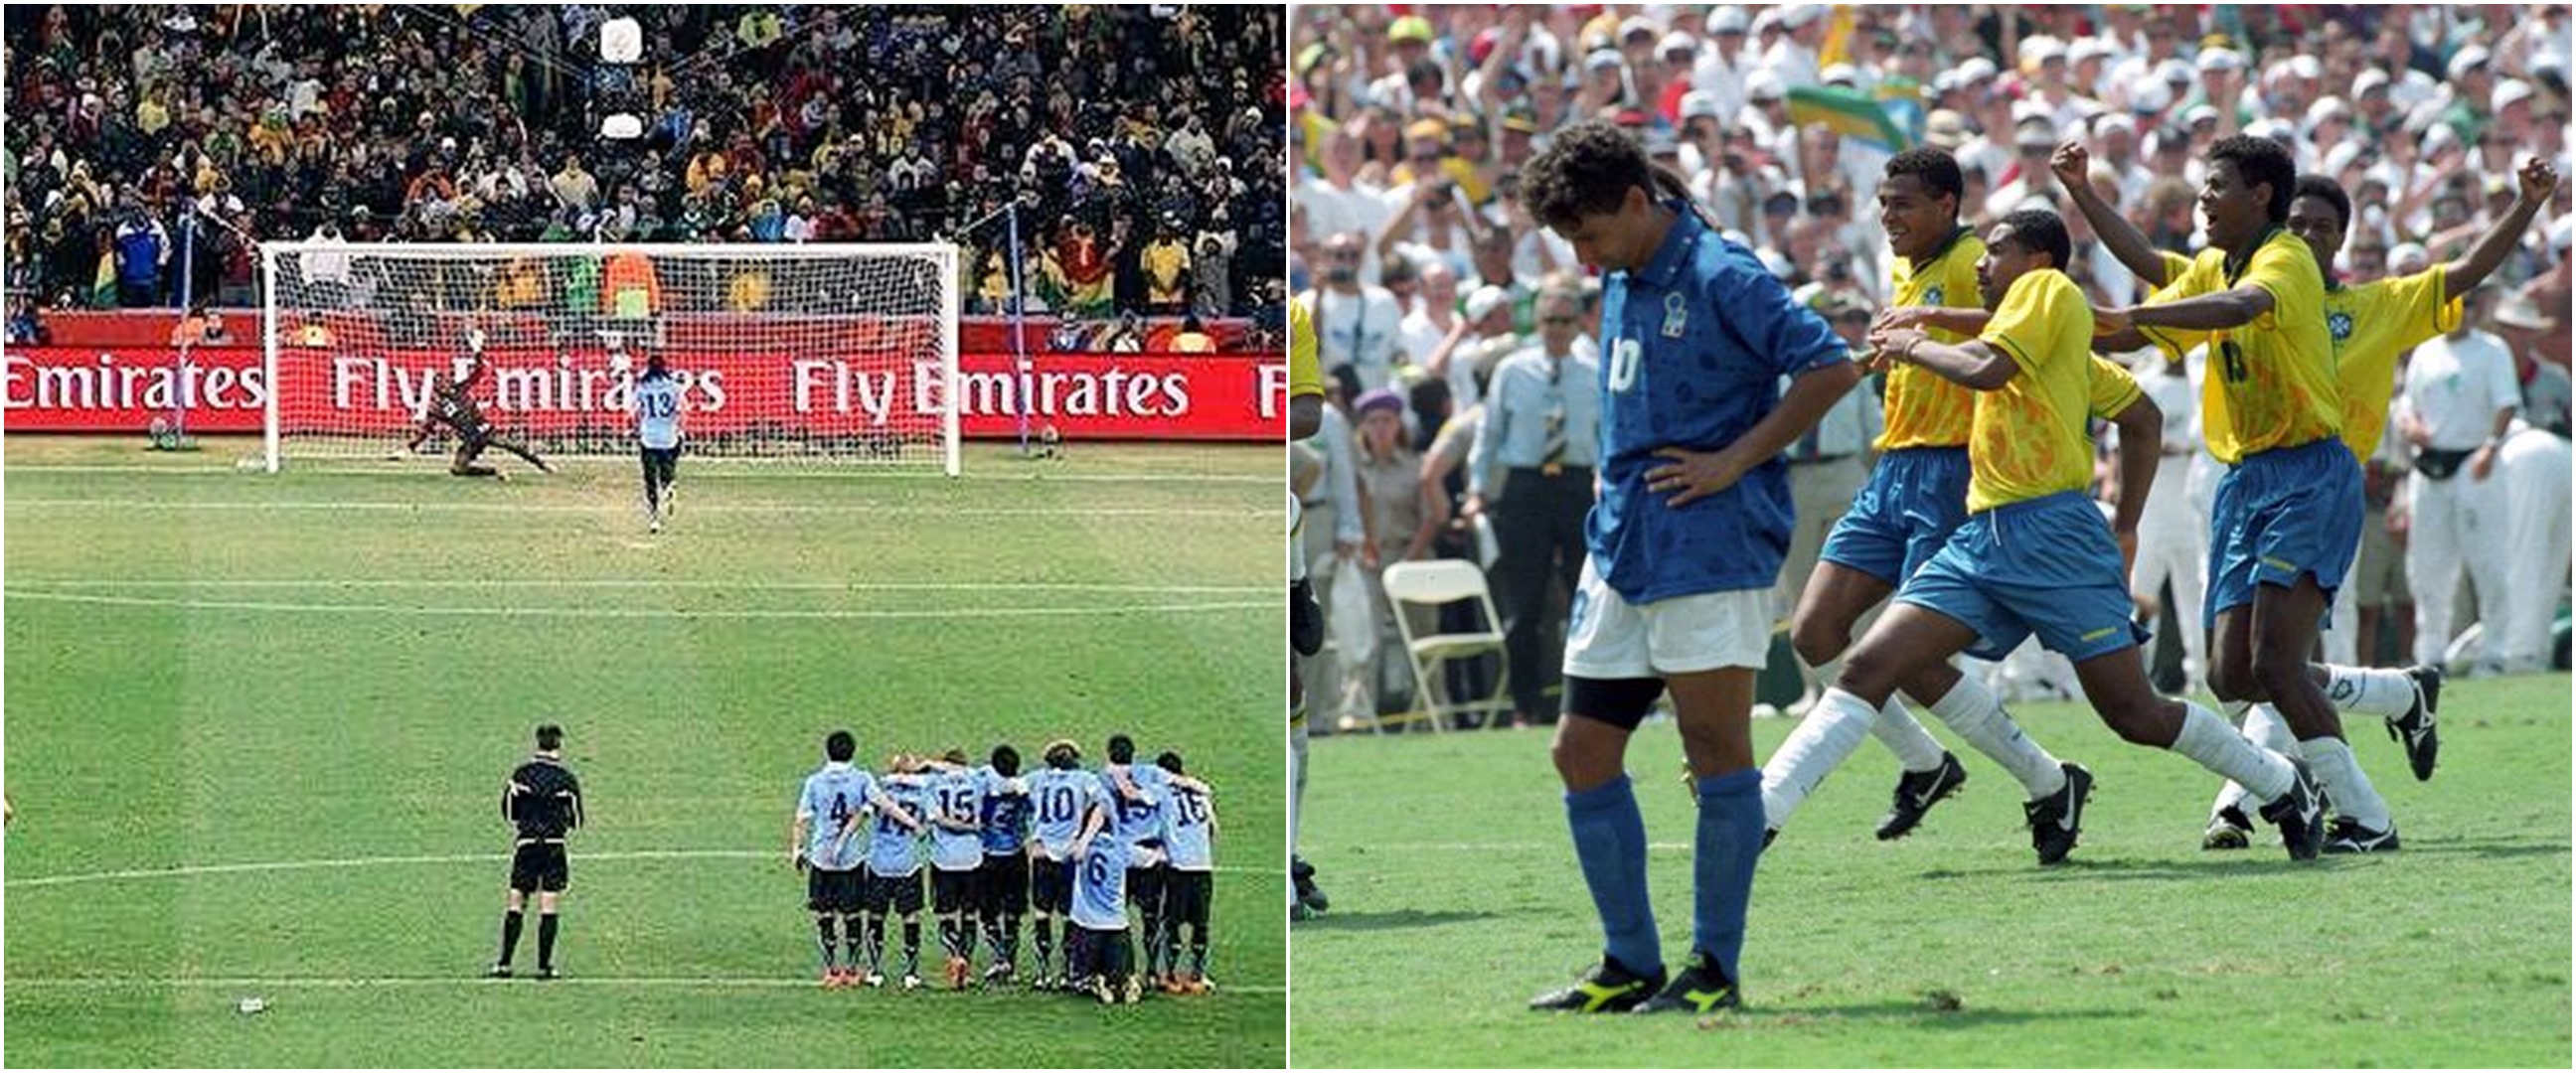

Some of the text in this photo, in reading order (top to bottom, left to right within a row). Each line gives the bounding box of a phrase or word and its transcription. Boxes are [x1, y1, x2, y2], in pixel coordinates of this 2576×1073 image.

[4, 354, 264, 409] Emirates
[1609, 337, 1640, 391] 10
[333, 357, 434, 420] Fly
[646, 392, 675, 417] 13
[794, 359, 1189, 424] Fly Emirates
[938, 789, 975, 823] 15
[1039, 786, 1073, 824] 10
[1088, 852, 1108, 887] 6
